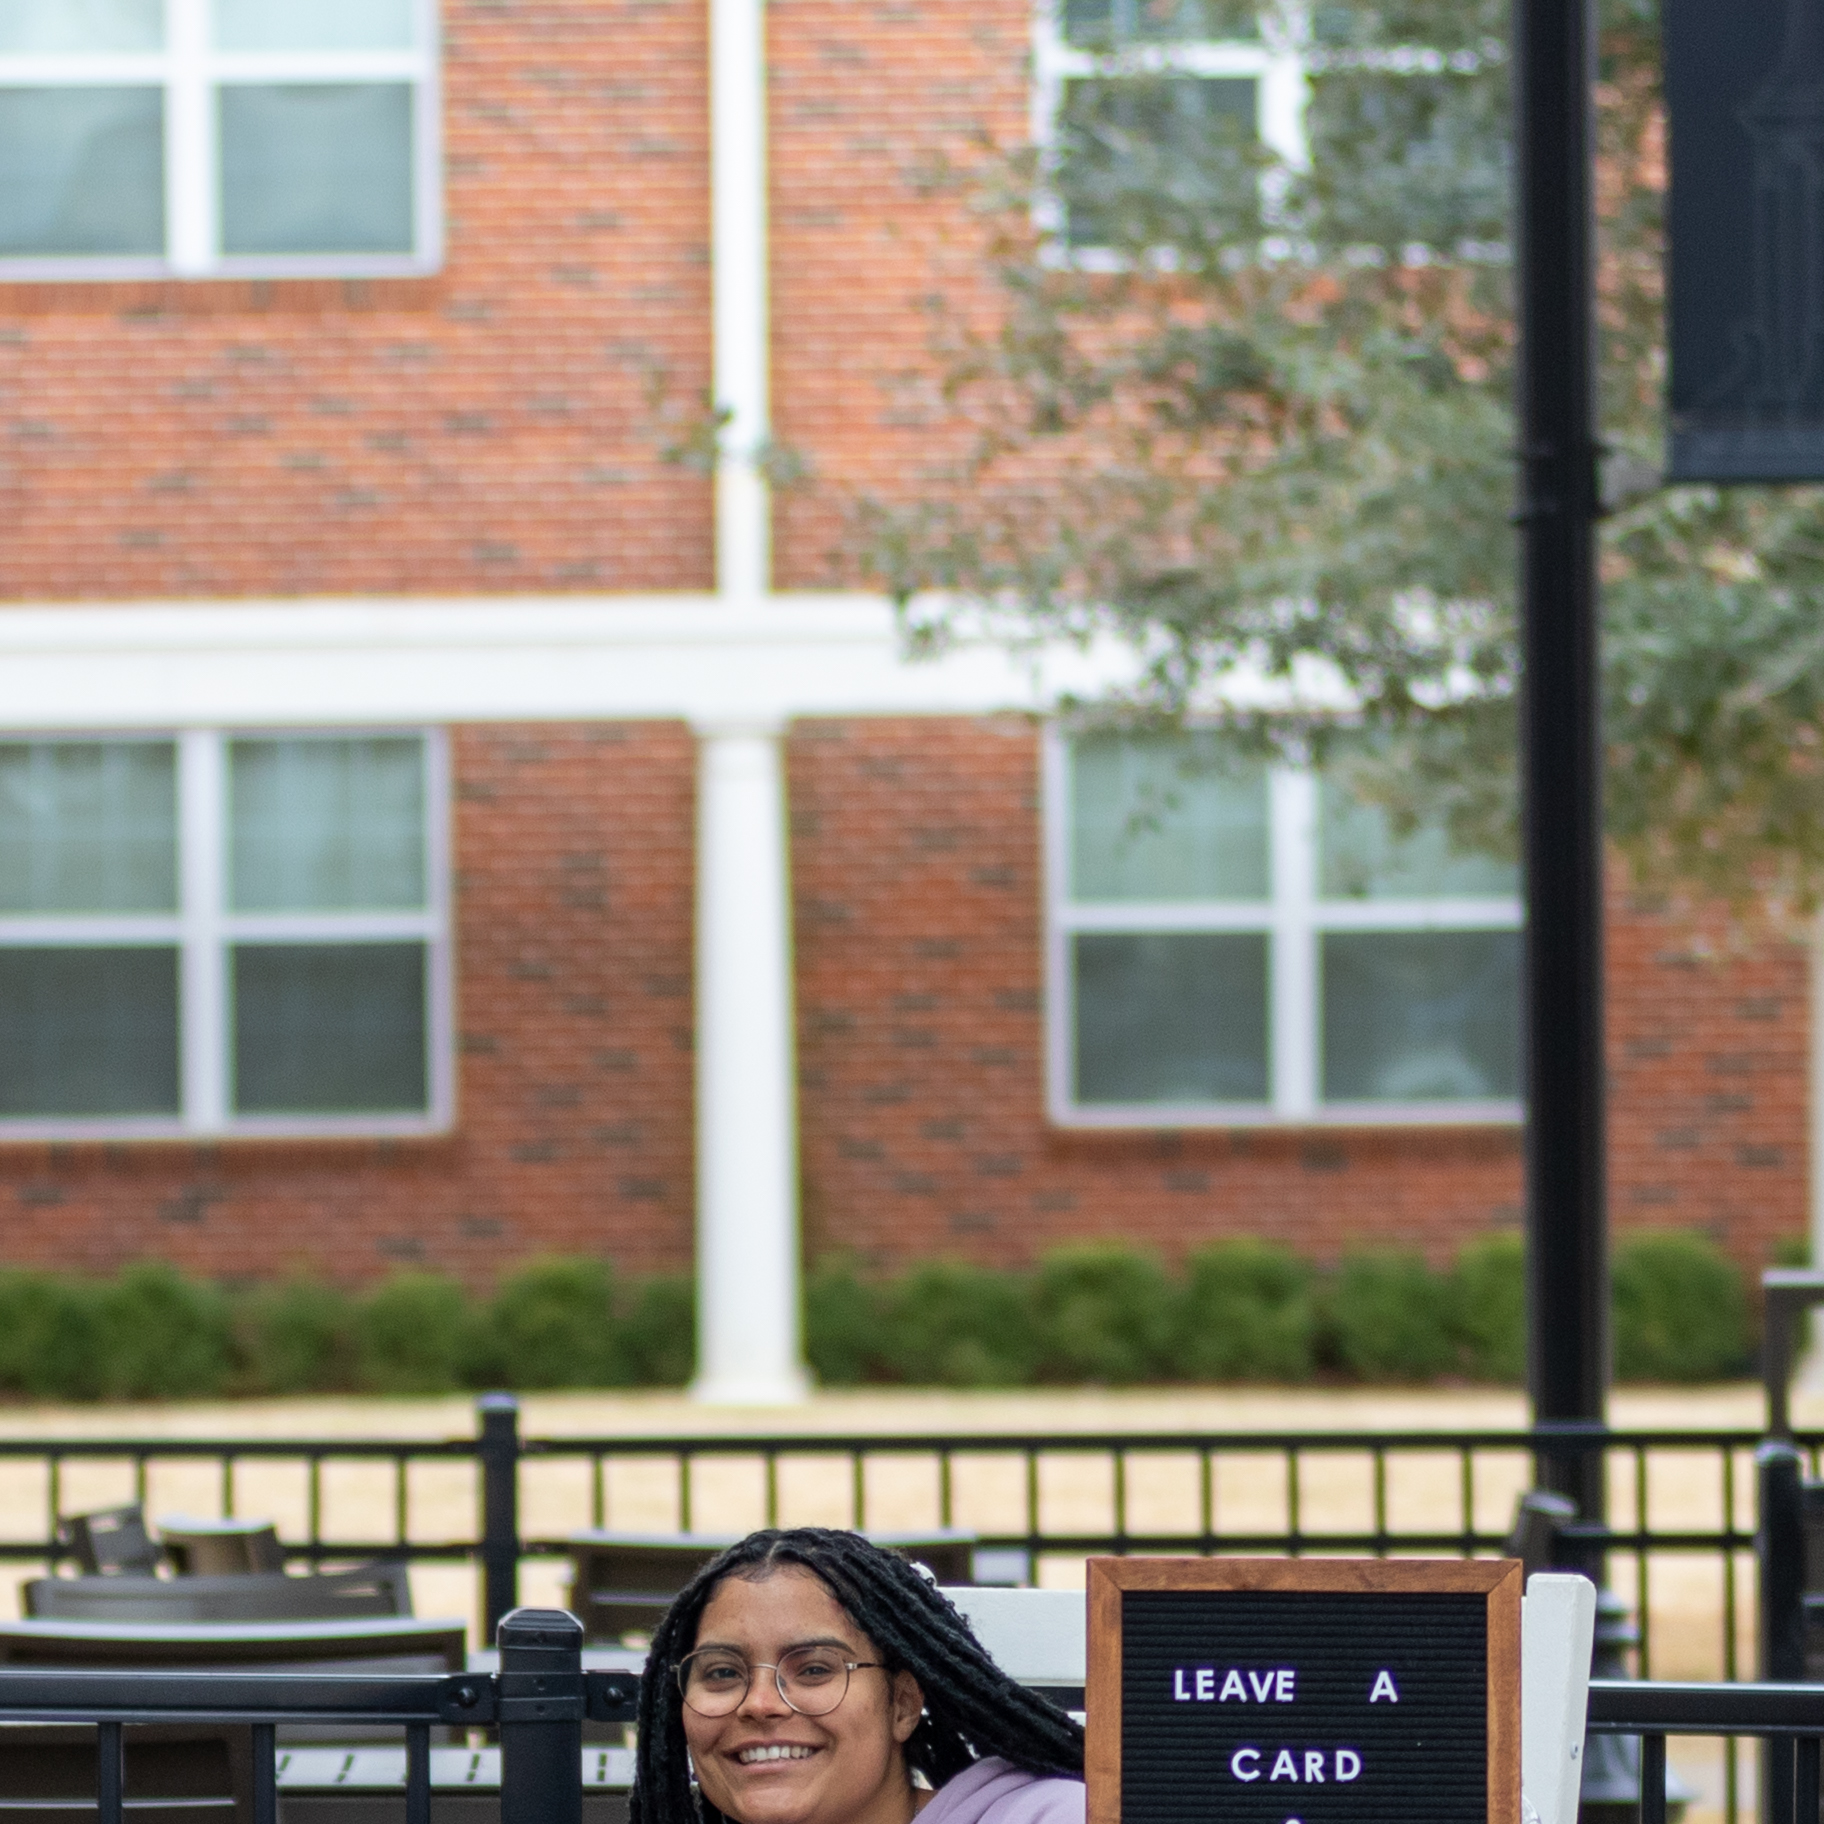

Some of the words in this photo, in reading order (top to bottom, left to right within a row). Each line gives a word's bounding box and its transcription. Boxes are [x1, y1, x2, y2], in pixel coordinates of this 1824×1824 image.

[1174, 1669, 1295, 1703] LEAVE
[1369, 1670, 1399, 1703] A
[1230, 1749, 1362, 1782] CARD
